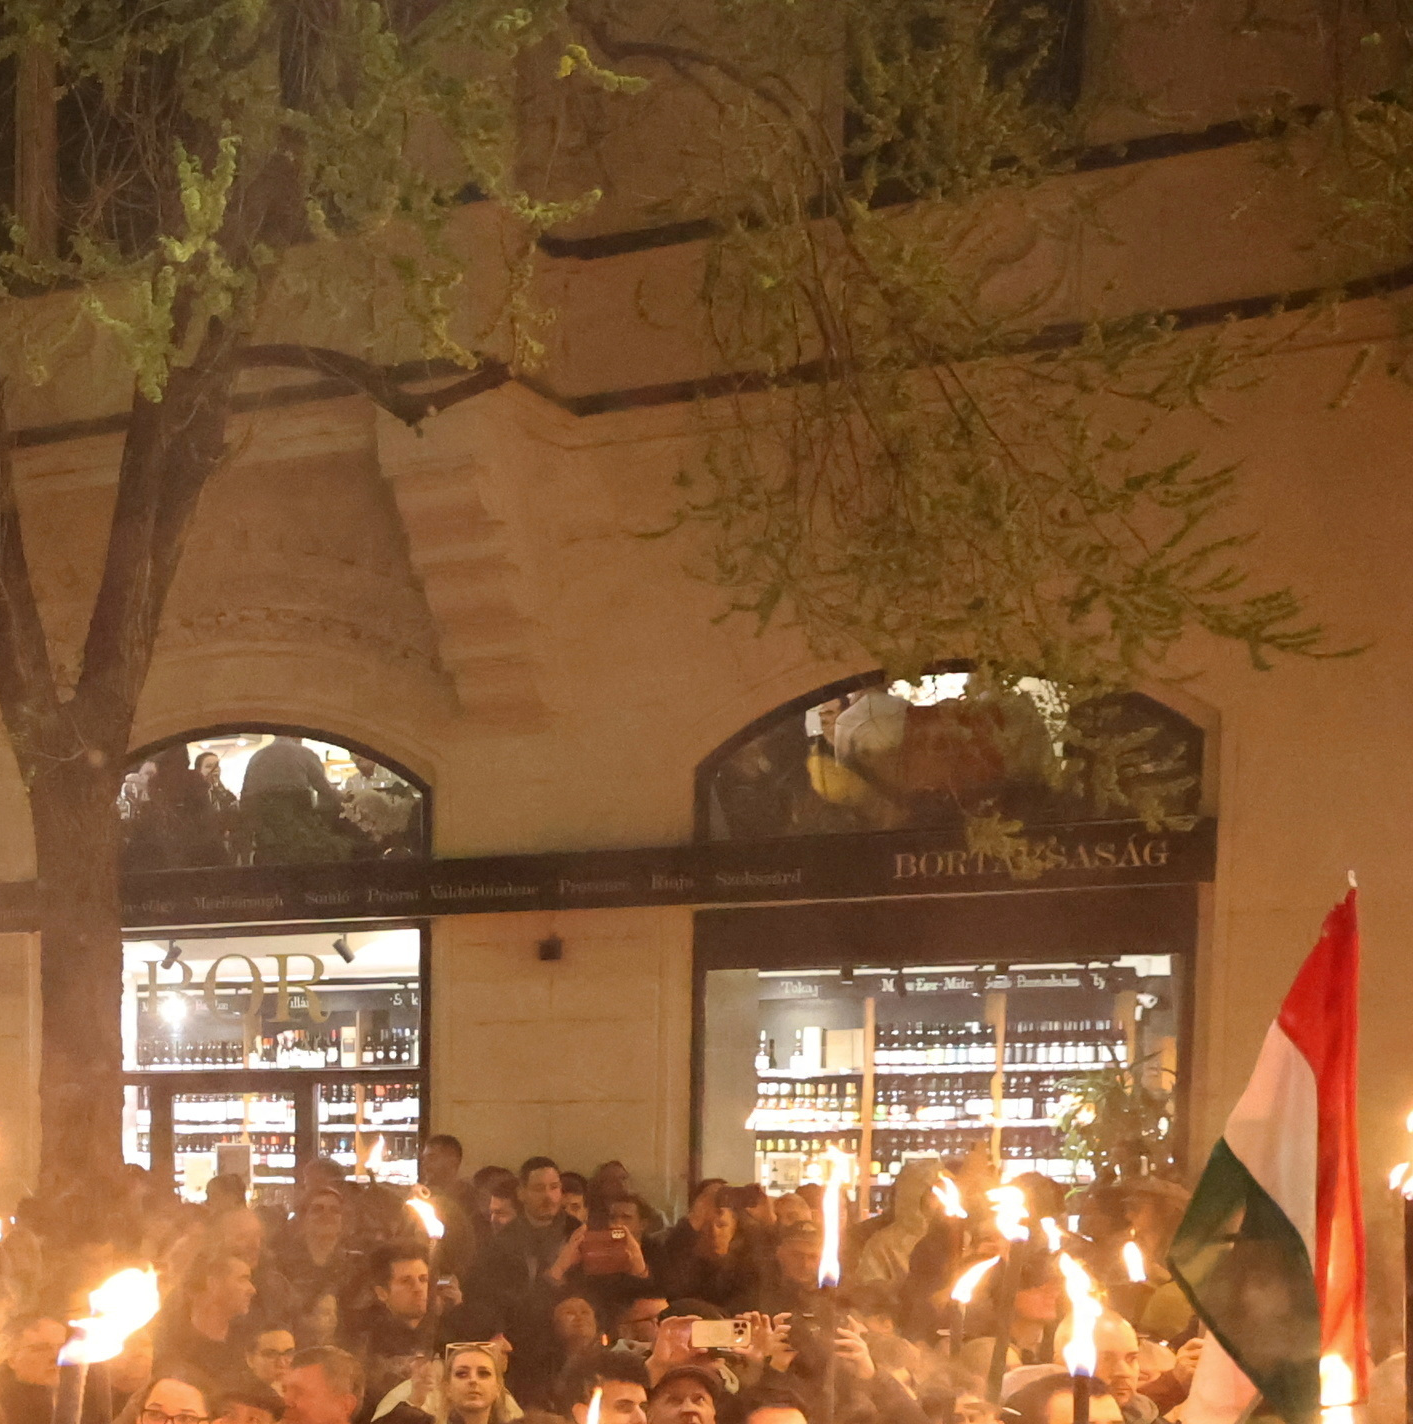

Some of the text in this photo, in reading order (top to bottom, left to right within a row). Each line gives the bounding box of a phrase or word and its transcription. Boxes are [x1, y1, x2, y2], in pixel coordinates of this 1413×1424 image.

[305, 889, 350, 905] Somló
[367, 887, 420, 903] Priorat
[429, 883, 540, 901] Valdobbiadene
[715, 868, 802, 887] Szekszárd
[143, 952, 332, 1024] BOR
[781, 981, 820, 999] Tokaj
